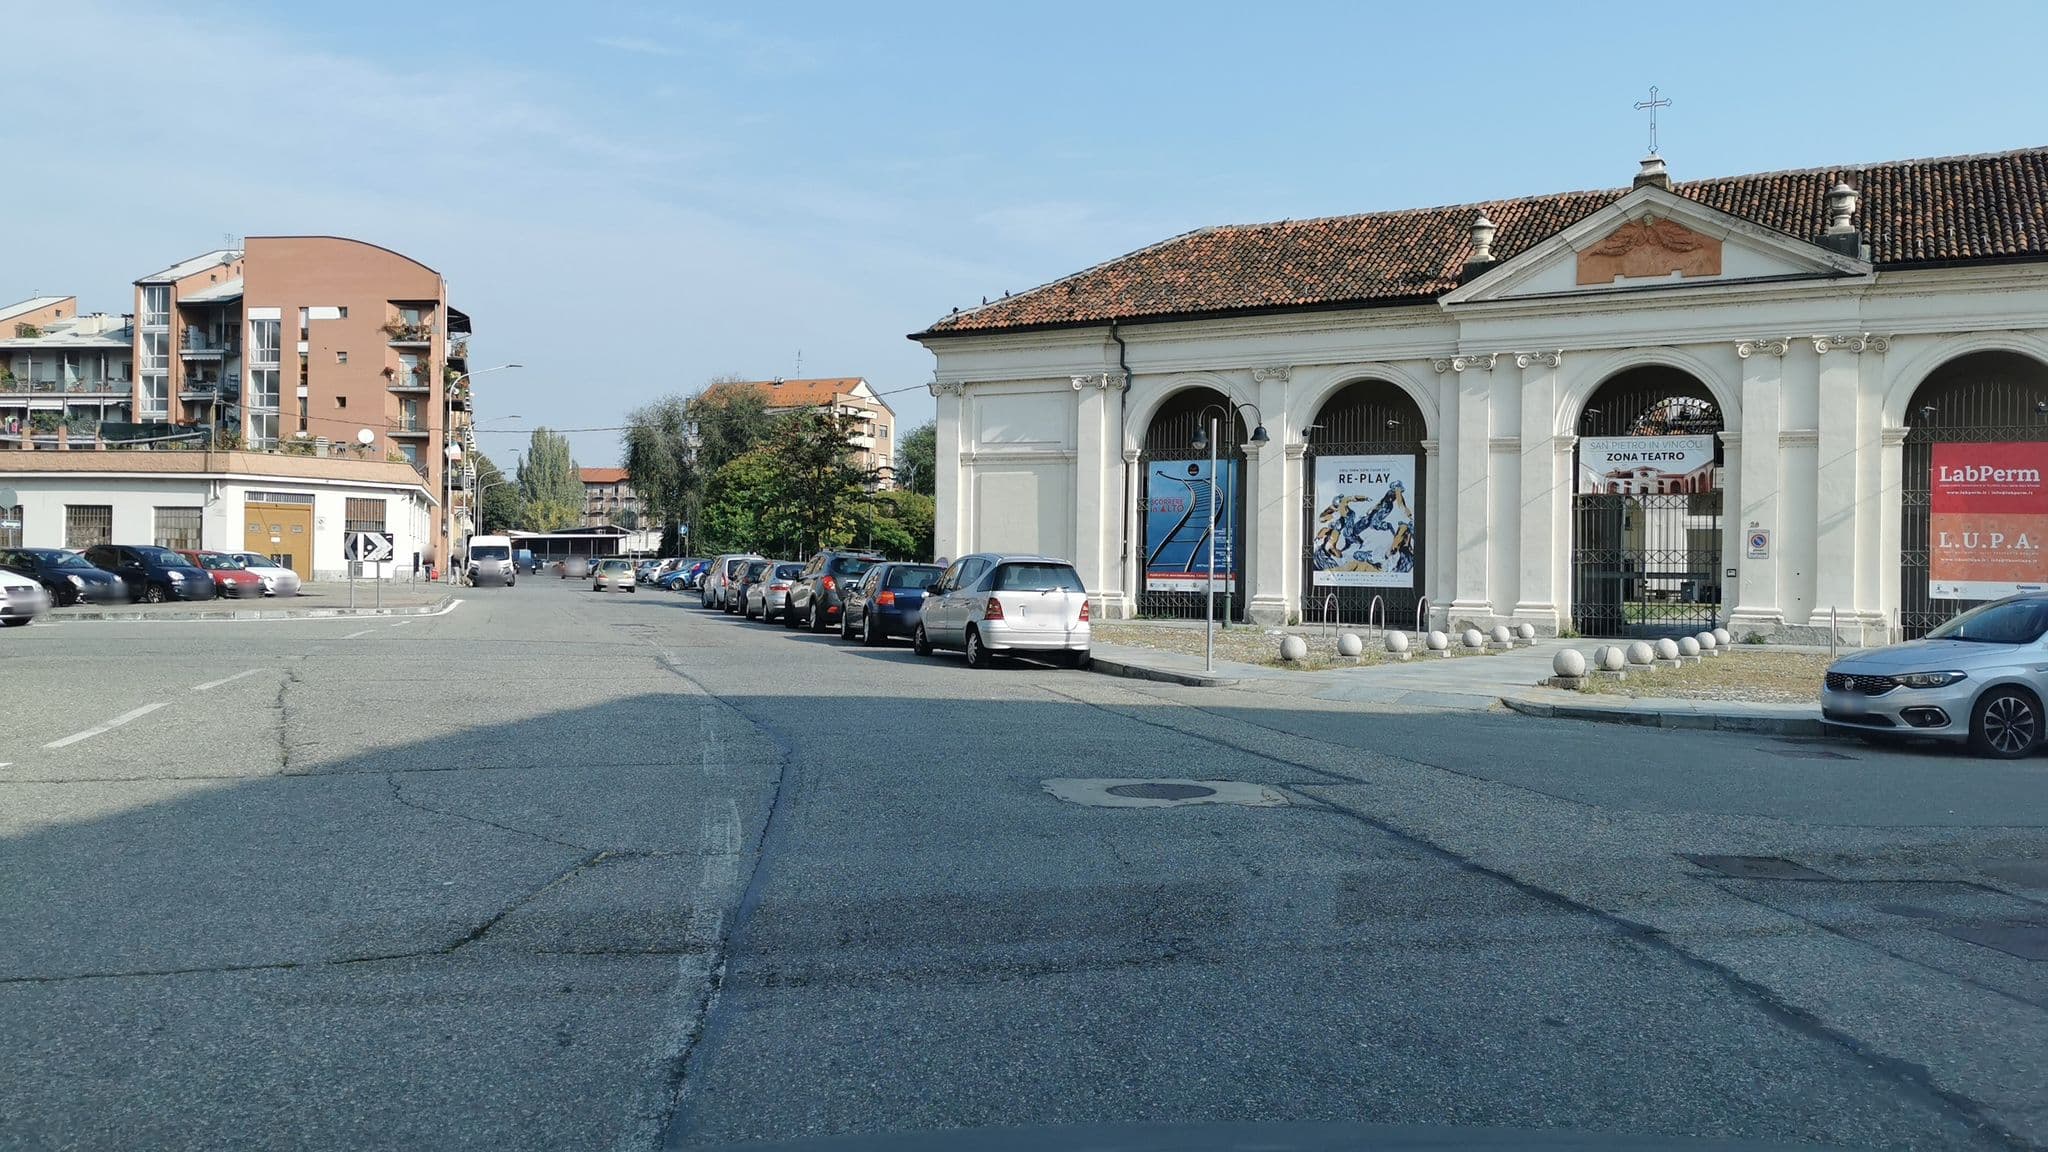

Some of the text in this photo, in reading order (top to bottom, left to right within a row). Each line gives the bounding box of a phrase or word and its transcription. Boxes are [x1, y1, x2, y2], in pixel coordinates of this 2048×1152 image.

[1590, 440, 1703, 449] SAN PIETRO IN VINCOLI
[1606, 452, 1685, 462] ZONA TEATRO
[1339, 473, 1390, 484] RE-PLAY
[1939, 465, 2041, 482] LabPerm
[1939, 532, 2039, 548] L.U.P.A.
